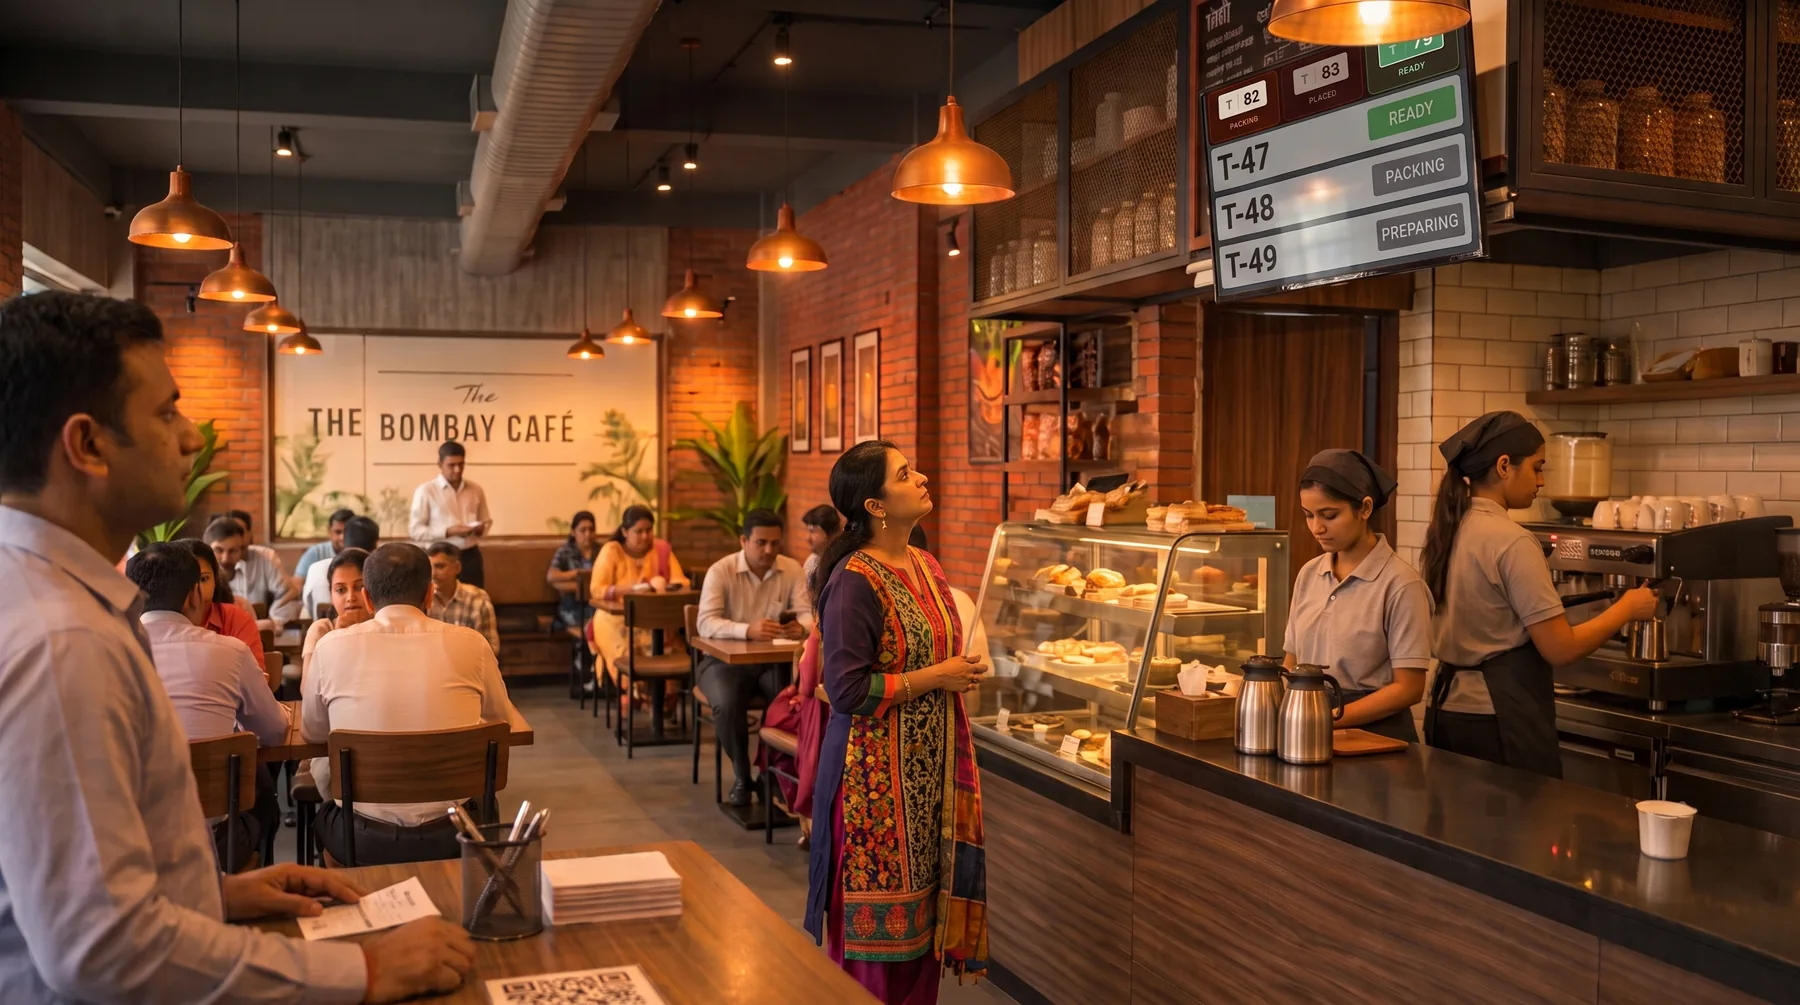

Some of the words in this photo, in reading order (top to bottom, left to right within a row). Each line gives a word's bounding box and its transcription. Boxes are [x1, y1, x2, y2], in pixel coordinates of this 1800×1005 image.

[1389, 44, 1396, 55] T
[1301, 73, 1309, 85] T
[1321, 62, 1340, 79] 83
[1398, 61, 1426, 76] READY
[1225, 99, 1233, 110] T
[1243, 89, 1260, 106] 82
[1308, 89, 1337, 104] PLACED
[1229, 115, 1259, 130] PACKING
[1388, 100, 1434, 126] READY
[1217, 141, 1270, 181] T-47
[1385, 157, 1445, 184] PACKING
[1221, 193, 1275, 230] T-48
[1381, 213, 1459, 242] PREPARING
[1225, 244, 1277, 279] T-49
[454, 383, 498, 405] The
[308, 408, 363, 437] THE
[380, 413, 496, 442] BOMBAY
[507, 410, 575, 442] CAFÉ
